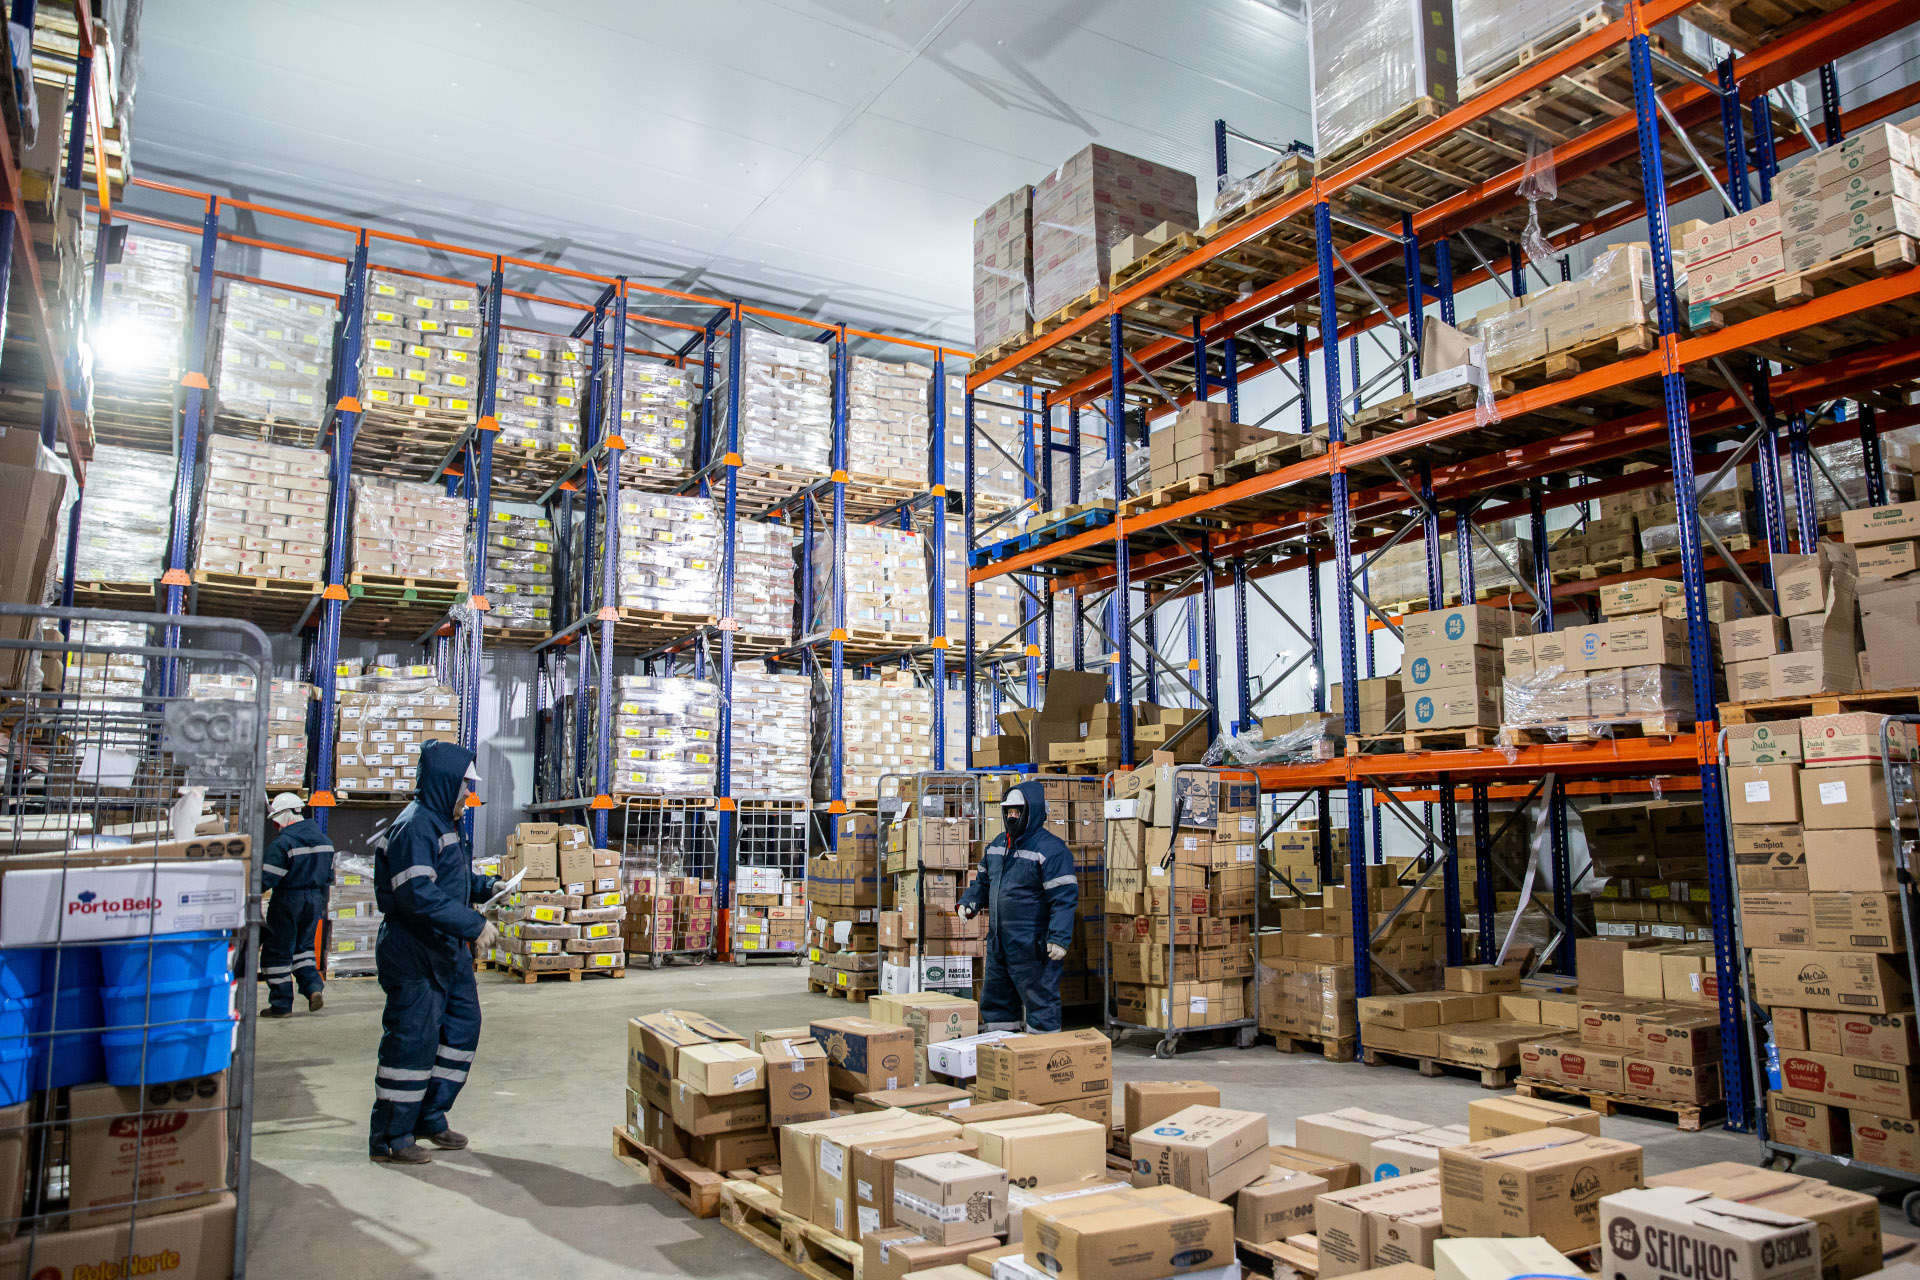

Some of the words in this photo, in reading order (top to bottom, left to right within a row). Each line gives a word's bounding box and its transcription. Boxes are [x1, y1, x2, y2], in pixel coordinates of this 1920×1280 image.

[1840, 144, 1865, 161] Dubai
[1845, 184, 1870, 202] Dubai
[1848, 221, 1872, 237] Dubai
[1415, 663, 1426, 671] Sei
[1415, 671, 1426, 679] Tu
[1418, 702, 1430, 711] Sei
[1419, 710, 1430, 718] Tu
[1751, 739, 1777, 752] Dubai
[1806, 740, 1825, 749] Dubai
[1753, 841, 1784, 851] Simplot
[68, 899, 121, 915] Porto
[122, 897, 162, 911] Belo
[1803, 970, 1828, 982] McCain
[1804, 986, 1830, 996] GOLAZO
[1586, 1018, 1600, 1026] Swift
[1848, 1023, 1869, 1032] Swift
[944, 1023, 963, 1035] Dubai
[1649, 1034, 1666, 1042] Swift
[1050, 1056, 1072, 1069] McCain
[1525, 1053, 1539, 1061] Swift
[1563, 1054, 1581, 1064] Swift
[1631, 1063, 1650, 1073] Swift
[1789, 1060, 1819, 1073] Swift
[119, 1112, 176, 1134] Swift
[1787, 1117, 1804, 1126] Swift
[1862, 1128, 1884, 1138] Swift
[1159, 1151, 1171, 1184] arita
[1574, 1175, 1600, 1196] McCain
[1574, 1201, 1599, 1217] GOURME
[1614, 1223, 1634, 1240] Sei
[1615, 1238, 1633, 1252] Tu
[1643, 1225, 1738, 1280] SEICHOC
[73, 1259, 121, 1280] Polo
[121, 1249, 181, 1277] Norte
